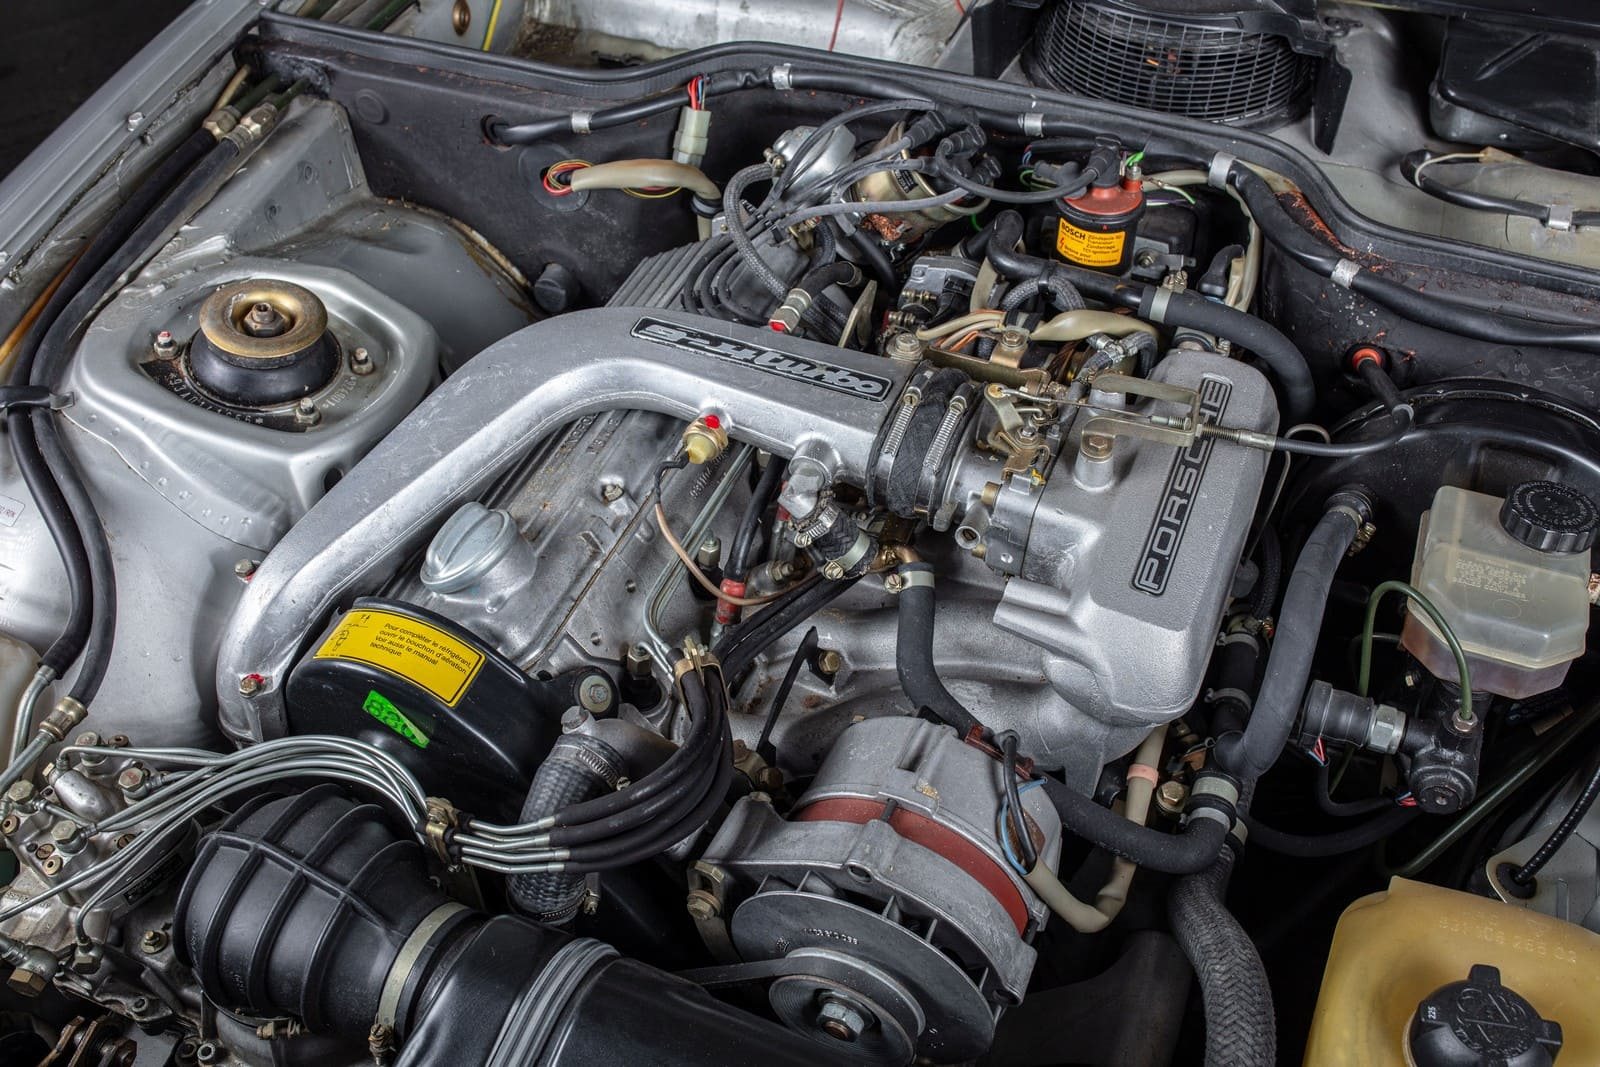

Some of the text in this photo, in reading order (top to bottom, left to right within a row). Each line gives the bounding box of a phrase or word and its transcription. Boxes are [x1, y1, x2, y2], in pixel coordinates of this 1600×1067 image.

[1062, 222, 1086, 240] BOSCH
[384, 623, 399, 631] Pour
[406, 638, 435, 654] bouchon
